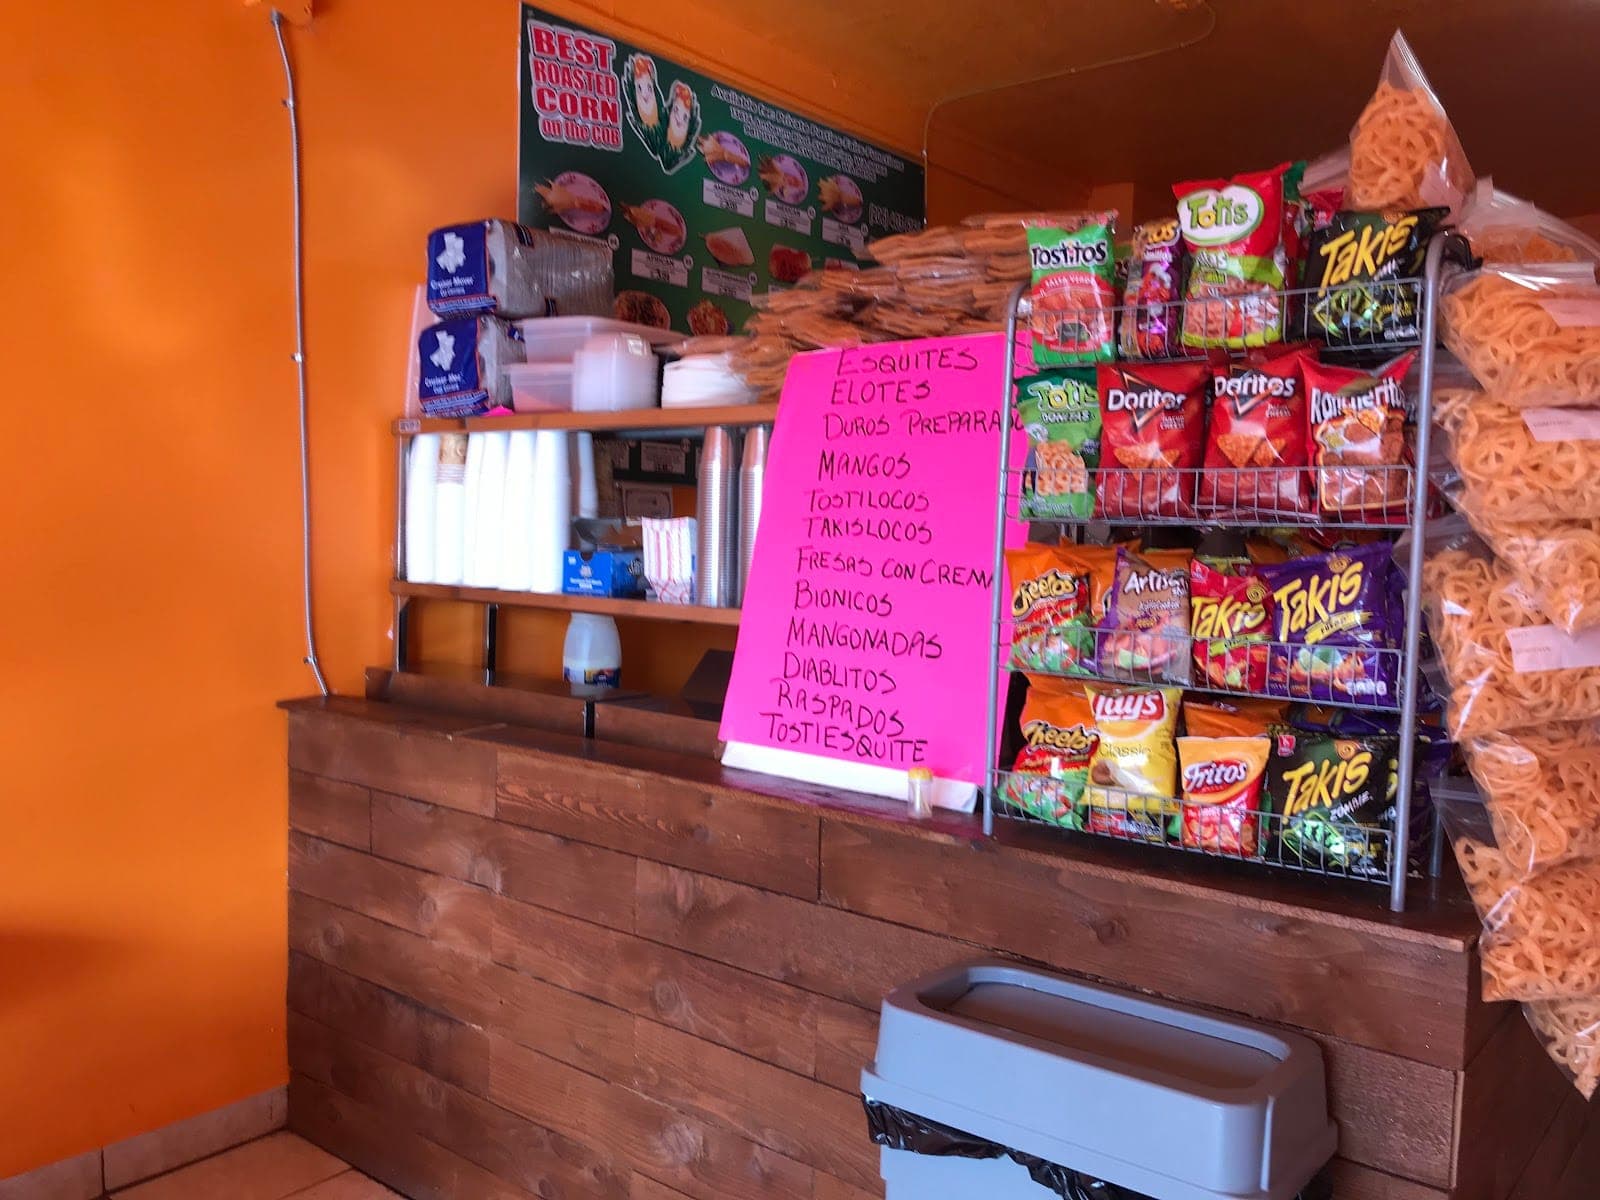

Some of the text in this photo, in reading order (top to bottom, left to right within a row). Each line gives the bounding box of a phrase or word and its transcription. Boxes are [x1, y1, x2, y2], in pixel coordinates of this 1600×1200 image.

[532, 26, 613, 71] BEST
[533, 57, 617, 98] ROASTED
[535, 87, 618, 125] CORN
[542, 118, 620, 146] on the COB
[1187, 195, 1249, 229] Totis
[1031, 241, 1107, 267] Tostitos
[1318, 215, 1419, 298] Takis
[837, 347, 978, 376] ESQUITES
[831, 379, 931, 405] ELOTES
[1107, 388, 1187, 412] Doritos
[1213, 373, 1297, 398] Doritos
[823, 412, 890, 441] DUROS
[818, 449, 911, 481] MANGOS
[796, 545, 873, 577] FRESAS
[881, 558, 916, 581] CON
[793, 578, 893, 617] BIONICOS
[1011, 571, 1077, 617] Cheetos
[1273, 560, 1364, 643] Takis
[1190, 594, 1267, 641] Takis
[786, 616, 943, 659] MANGONADAS
[783, 651, 897, 694] DIABLITOS
[770, 677, 905, 738] RASPADOS
[759, 711, 929, 763] TOSTIESQUITE
[1184, 761, 1247, 793] Fritos
[1281, 751, 1373, 825] Takis
